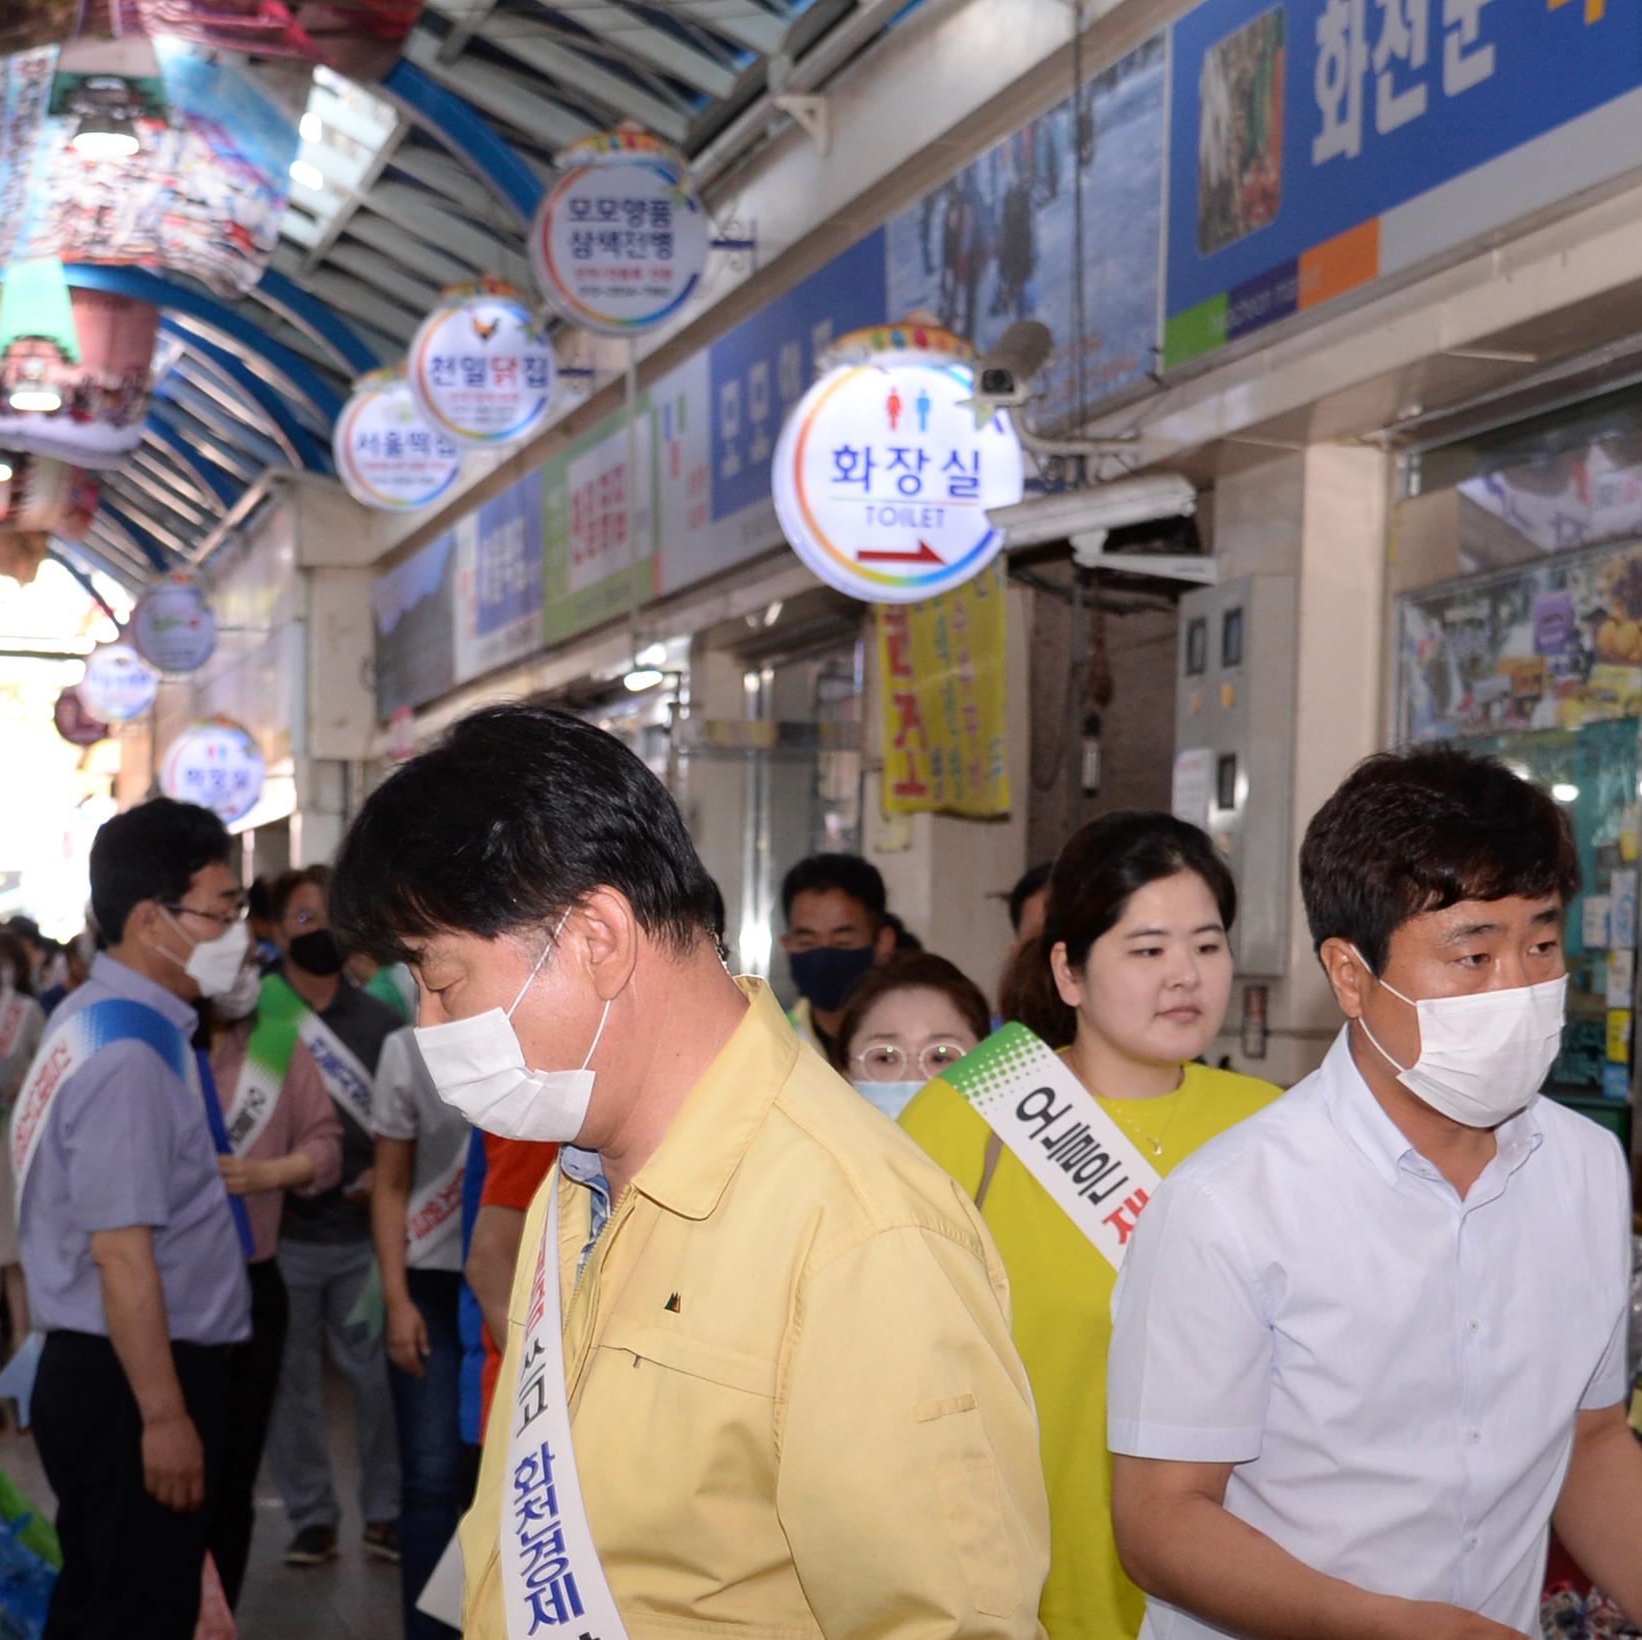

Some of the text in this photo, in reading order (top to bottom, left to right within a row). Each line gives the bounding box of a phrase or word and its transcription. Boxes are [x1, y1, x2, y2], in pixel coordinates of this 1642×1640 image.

[830, 444, 981, 498] 화장실
[865, 506, 946, 528] TOILET
[513, 1442, 585, 1637] 화천경제
